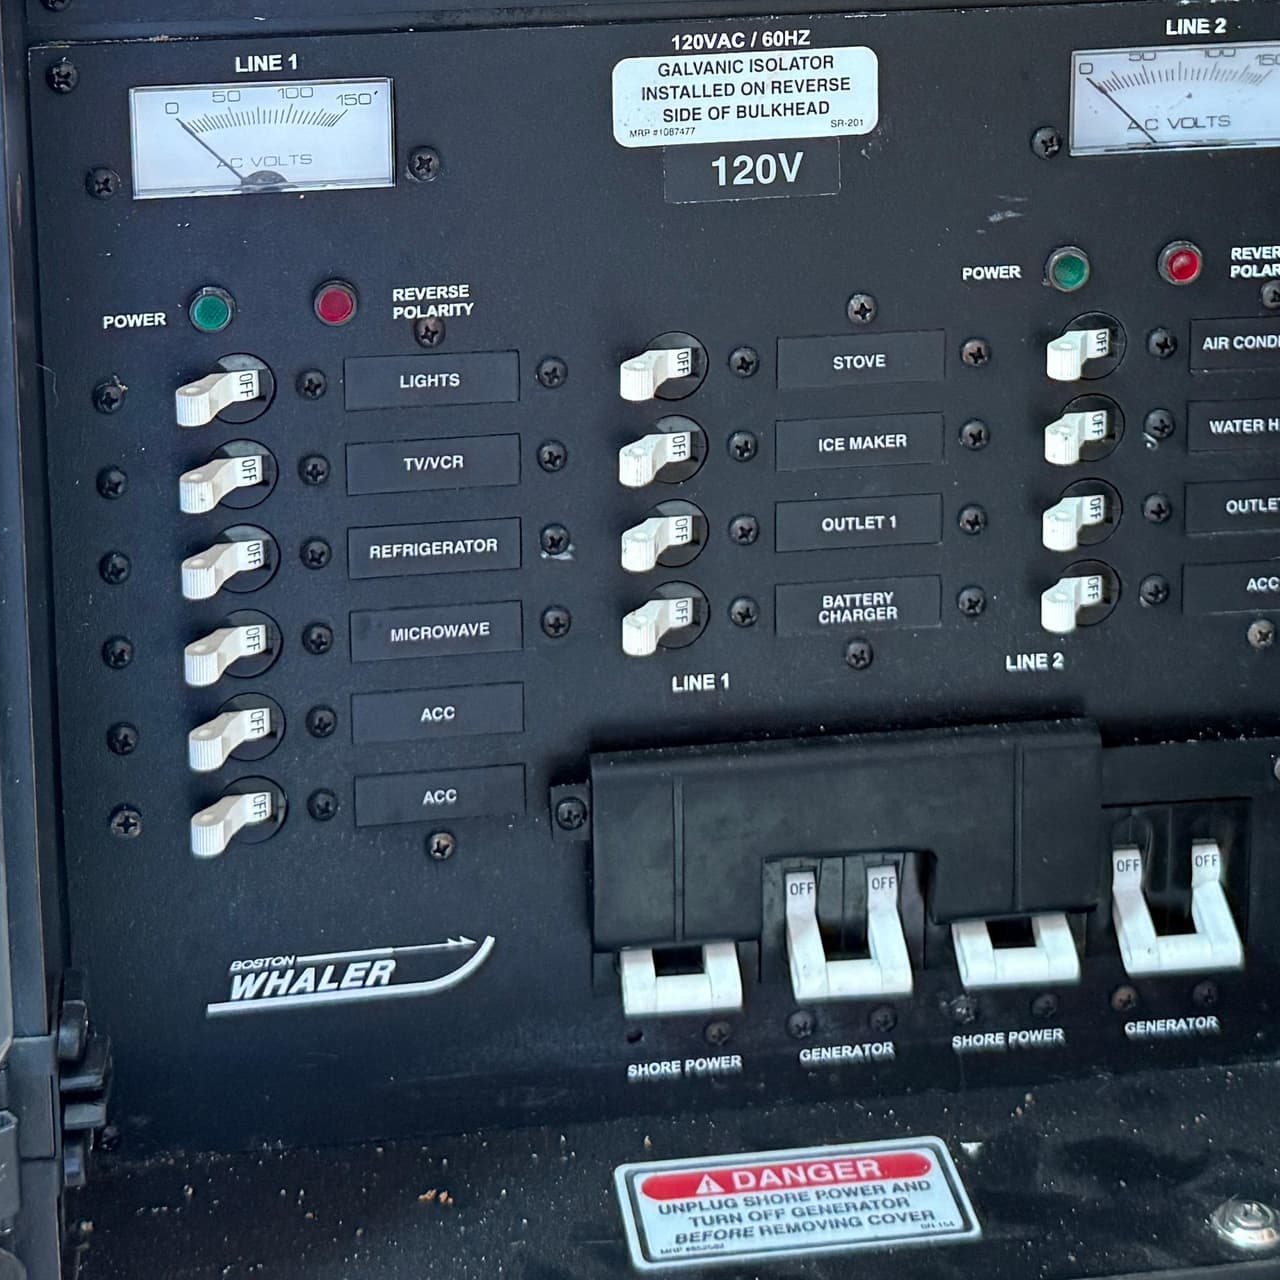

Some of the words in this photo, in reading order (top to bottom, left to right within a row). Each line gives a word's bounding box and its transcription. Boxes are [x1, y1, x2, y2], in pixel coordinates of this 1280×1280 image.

[1165, 18, 1210, 36] LINE
[1214, 18, 1227, 35] 2
[671, 32, 745, 52] 120VAC
[761, 29, 811, 47] 60HZ
[234, 54, 283, 72] LINE
[288, 53, 298, 70] 1
[657, 59, 744, 78] GALVANIC
[748, 54, 835, 73] ISOLATOR
[1078, 62, 1094, 75] 0
[212, 90, 241, 103] 50
[277, 87, 314, 99] 100
[641, 81, 735, 102] INSTALLED
[740, 80, 766, 96] ON
[770, 77, 851, 95] REVERSE
[165, 102, 180, 115] 0
[335, 93, 372, 106] 150
[662, 107, 704, 123] SIDE
[708, 105, 731, 121] OF
[736, 101, 830, 119] BULKHEAD
[830, 119, 864, 128] SR-201
[1127, 118, 1159, 131] AC
[1167, 115, 1232, 130] VOLTS
[250, 154, 313, 167] VOLTS
[711, 151, 804, 186] 120V
[961, 264, 1022, 281] POWER
[392, 284, 470, 302] REVERSE
[393, 302, 475, 320] POLARITY
[103, 312, 167, 329] POWER
[1095, 331, 1108, 354] OFF
[1202, 336, 1229, 351] AIR
[832, 354, 886, 370] STOVE
[399, 373, 461, 389] LIGHTS
[1209, 418, 1265, 435] WATER
[671, 435, 686, 460] OFF
[818, 436, 847, 453] ICE
[849, 433, 907, 450] MAKER
[242, 458, 257, 483] OFF
[403, 455, 464, 471] TV/VCR
[821, 516, 884, 532] OUTLET
[888, 515, 896, 529] 1
[369, 538, 498, 559] REFRIGERATOR
[1086, 577, 1100, 601] OFF
[822, 591, 894, 609] BATTERY
[818, 607, 898, 624] CHARGER
[390, 622, 491, 642] MICROWAVE
[1005, 654, 1048, 672] LINE
[1051, 653, 1064, 670] 2
[671, 675, 716, 693] LINE
[720, 673, 730, 690] 1
[421, 706, 456, 722] ACC
[249, 711, 265, 736] OFF
[422, 788, 457, 804] ACC
[1116, 858, 1141, 873] OFF
[1194, 853, 1219, 868] OFF
[789, 882, 814, 896] OFF
[871, 876, 896, 891] OFF
[229, 955, 296, 972] BOSTON
[230, 959, 397, 1000] WHALER
[1124, 1015, 1220, 1035] GENERATOR
[951, 1032, 1006, 1049] SHORE
[1008, 1028, 1065, 1045] POWER
[799, 1041, 895, 1062] GENERATOR
[627, 1060, 682, 1078] SHORE
[685, 1055, 743, 1073] POWER
[732, 1158, 883, 1191] DANGER
[658, 1197, 738, 1216] UNPLUG
[743, 1190, 810, 1207] SHORE
[814, 1184, 889, 1202] POWER
[892, 1179, 932, 1193] AND
[688, 1212, 744, 1228] TURN
[748, 1206, 787, 1222] OFF
[790, 1196, 910, 1218] GENERATOR
[675, 1226, 755, 1245] BEFORE
[759, 1215, 863, 1237] REMOVING
[864, 1209, 936, 1230] COVER
